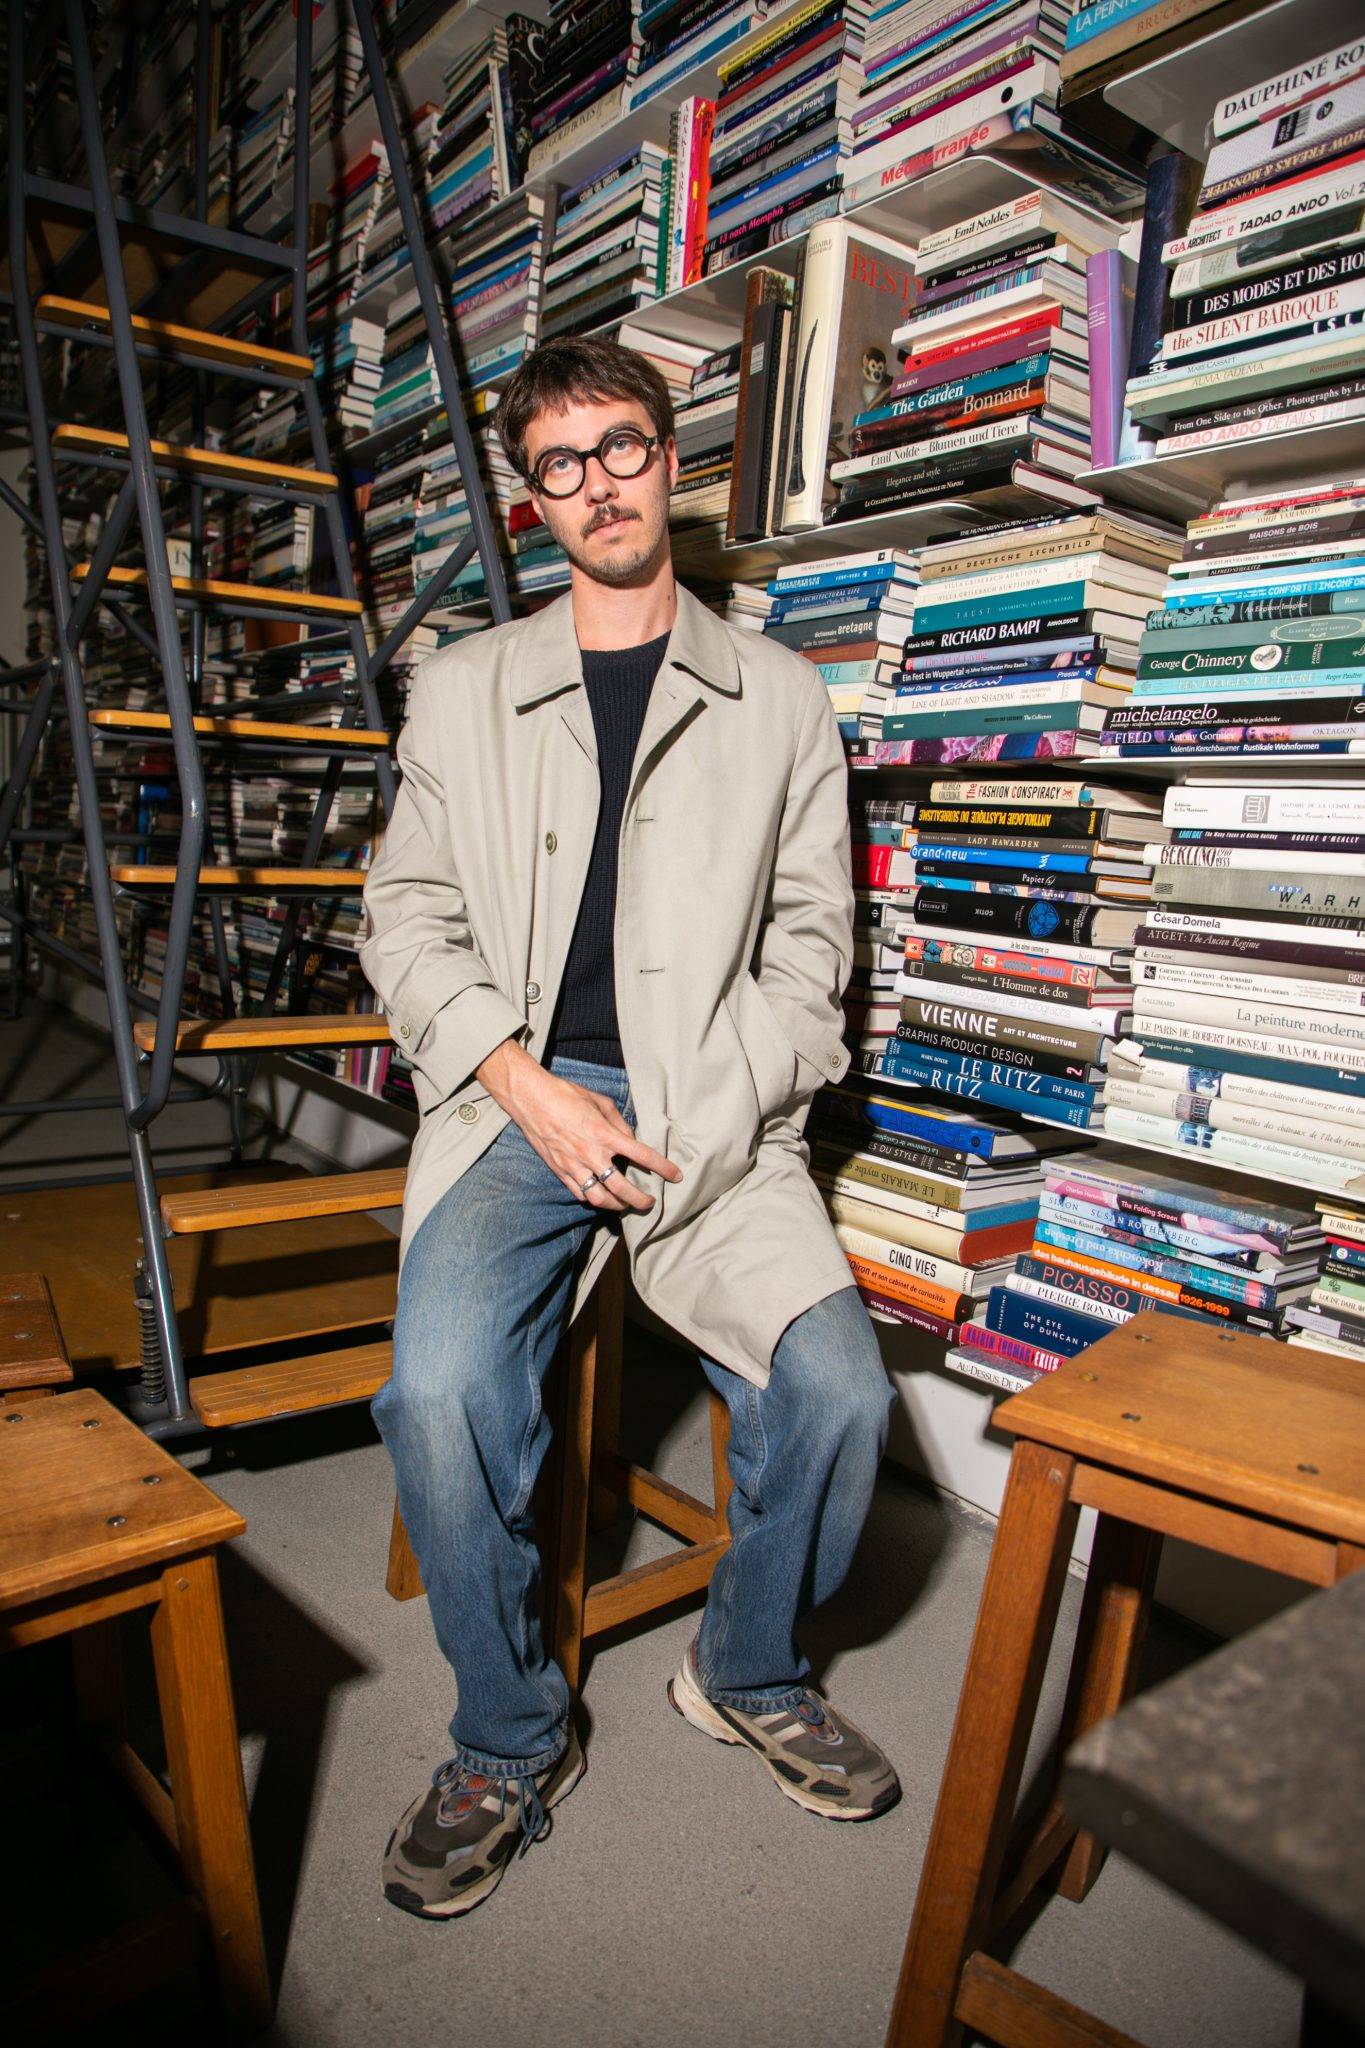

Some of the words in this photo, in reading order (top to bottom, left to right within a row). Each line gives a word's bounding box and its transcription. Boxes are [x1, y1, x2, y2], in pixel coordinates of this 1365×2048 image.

[1076, 13, 1092, 32] LA
[880, 126, 990, 187] Méditerranée
[749, 205, 784, 230] Memphis
[1239, 210, 1282, 233] TADAO
[1286, 194, 1329, 218] ANDO
[954, 222, 975, 240] Emil
[976, 211, 1010, 231] Noldes
[1203, 293, 1229, 315] DES
[1231, 277, 1280, 305] MODES
[1283, 270, 1304, 290] ET
[1307, 260, 1336, 283] DES
[1172, 333, 1193, 352] the
[1196, 314, 1253, 345] SILENT
[1257, 290, 1339, 328] BAROQUE
[892, 398, 914, 417] The
[917, 385, 964, 408] Garden
[963, 379, 1030, 415] Bonnard
[1174, 421, 1194, 432] From
[1196, 416, 1211, 427] One
[1214, 412, 1231, 424] Side
[1233, 409, 1242, 418] to
[1243, 405, 1256, 417] the
[1286, 389, 1339, 409] Photographs
[1341, 386, 1352, 397] by
[871, 453, 892, 466] Emil
[894, 447, 920, 462] Nolde
[929, 436, 966, 453] Blumen
[969, 431, 989, 444] und
[992, 424, 1019, 439] Tiere
[1166, 433, 1212, 450] TADAO
[1216, 421, 1261, 439] ANDO
[886, 474, 912, 488] Elegance
[913, 472, 925, 481] and
[926, 467, 941, 480] style
[970, 524, 1001, 535] HUNGARIAN
[1249, 528, 1285, 540] MAISONS
[1298, 522, 1319, 532] BOIS
[940, 565, 958, 573] DAS
[966, 553, 1021, 568] DEUTSCHE
[1029, 539, 1091, 558] LICHTBILD
[941, 626, 996, 648] RICHARD
[999, 619, 1041, 639] BAMPI
[1150, 660, 1181, 669] George
[1181, 653, 1247, 672] Chinnery
[903, 673, 911, 682] Ein
[913, 671, 924, 681] Fest
[926, 671, 931, 679] in
[932, 668, 965, 679] Wuppertal
[912, 700, 928, 709] LINE
[940, 695, 962, 707] LIGHT
[963, 695, 980, 704] AND
[981, 691, 1014, 703] SHADOW
[1112, 703, 1218, 726] michelangelo
[1114, 731, 1152, 744] FIELD
[1168, 732, 1198, 742] Antony
[1312, 727, 1357, 736] OKTAGON
[1170, 745, 1195, 753] Valentin
[1243, 743, 1273, 751] Rustikale
[1274, 742, 1319, 750] Wohnformen
[977, 786, 1010, 798] FASHION
[1011, 786, 1061, 800] CONSPIRACY
[967, 837, 989, 845] LADY
[992, 838, 1040, 848] HAWARDEN
[1160, 845, 1216, 866] BERLINO
[1022, 873, 1045, 885] Papier
[1269, 885, 1301, 893] ANDY
[1153, 913, 1182, 925] César
[1183, 915, 1221, 929] Domela
[1147, 930, 1187, 942] ATGET:
[1189, 933, 1203, 944] The
[1203, 935, 1230, 946] Ancien
[1231, 936, 1261, 950] Regime
[992, 976, 1037, 994] L'Homme
[1039, 985, 1050, 996] de
[1052, 987, 1068, 999] dos
[920, 1003, 999, 1037] VIENNE
[1017, 1029, 1026, 1037] ET
[1027, 1031, 1078, 1049] ARCHITECTURE
[1236, 1008, 1252, 1022] La
[1255, 1014, 1306, 1030] peinture
[1141, 1022, 1151, 1031] LE
[1153, 1024, 1177, 1035] PARIS
[1179, 1028, 1190, 1038] DE
[1192, 1030, 1224, 1044] ROBERT
[897, 1026, 938, 1045] GRAPHIS
[940, 1036, 987, 1056] PRODUCT
[991, 1047, 1034, 1067] DESIGN
[913, 1070, 928, 1079] PARIS
[931, 1069, 983, 1099] RITZ
[959, 1057, 987, 1079] LE
[990, 1064, 1043, 1094] RITZ
[1052, 1084, 1063, 1095] DE
[1065, 1088, 1085, 1099] PARIS
[880, 1144, 892, 1154] DU
[894, 1148, 917, 1162] STYLE
[881, 1173, 919, 1192] MARAIS
[924, 1185, 936, 1197] LE
[1065, 1186, 1082, 1195] Charles
[1048, 1197, 1079, 1211] SIMON
[1121, 1201, 1132, 1209] The
[1133, 1204, 1156, 1217] Folding
[1157, 1211, 1178, 1222] Screen
[1090, 1209, 1124, 1225] SUSAN
[1128, 1220, 1198, 1246] ROTHENBERG
[889, 1250, 912, 1269] CINQ
[916, 1257, 937, 1278] VIES
[878, 1274, 888, 1282] son
[889, 1278, 909, 1291] cabinet
[910, 1285, 918, 1293] de
[918, 1288, 946, 1304] curiosités
[1034, 1249, 1049, 1259] das
[1051, 1253, 1130, 1284] bauhausgebäude
[1131, 1278, 1140, 1286] in
[1140, 1282, 1179, 1300] dessau
[1180, 1294, 1230, 1316] 1926-1999
[1042, 1266, 1129, 1308] PICASSO
[1037, 1286, 1079, 1311] PIERRE
[1025, 1312, 1041, 1323] THE
[1046, 1319, 1062, 1329] EYE
[1023, 1322, 1035, 1331] OF
[1039, 1327, 1078, 1345] DUNCAN
[1034, 1350, 1060, 1372] EXITS
